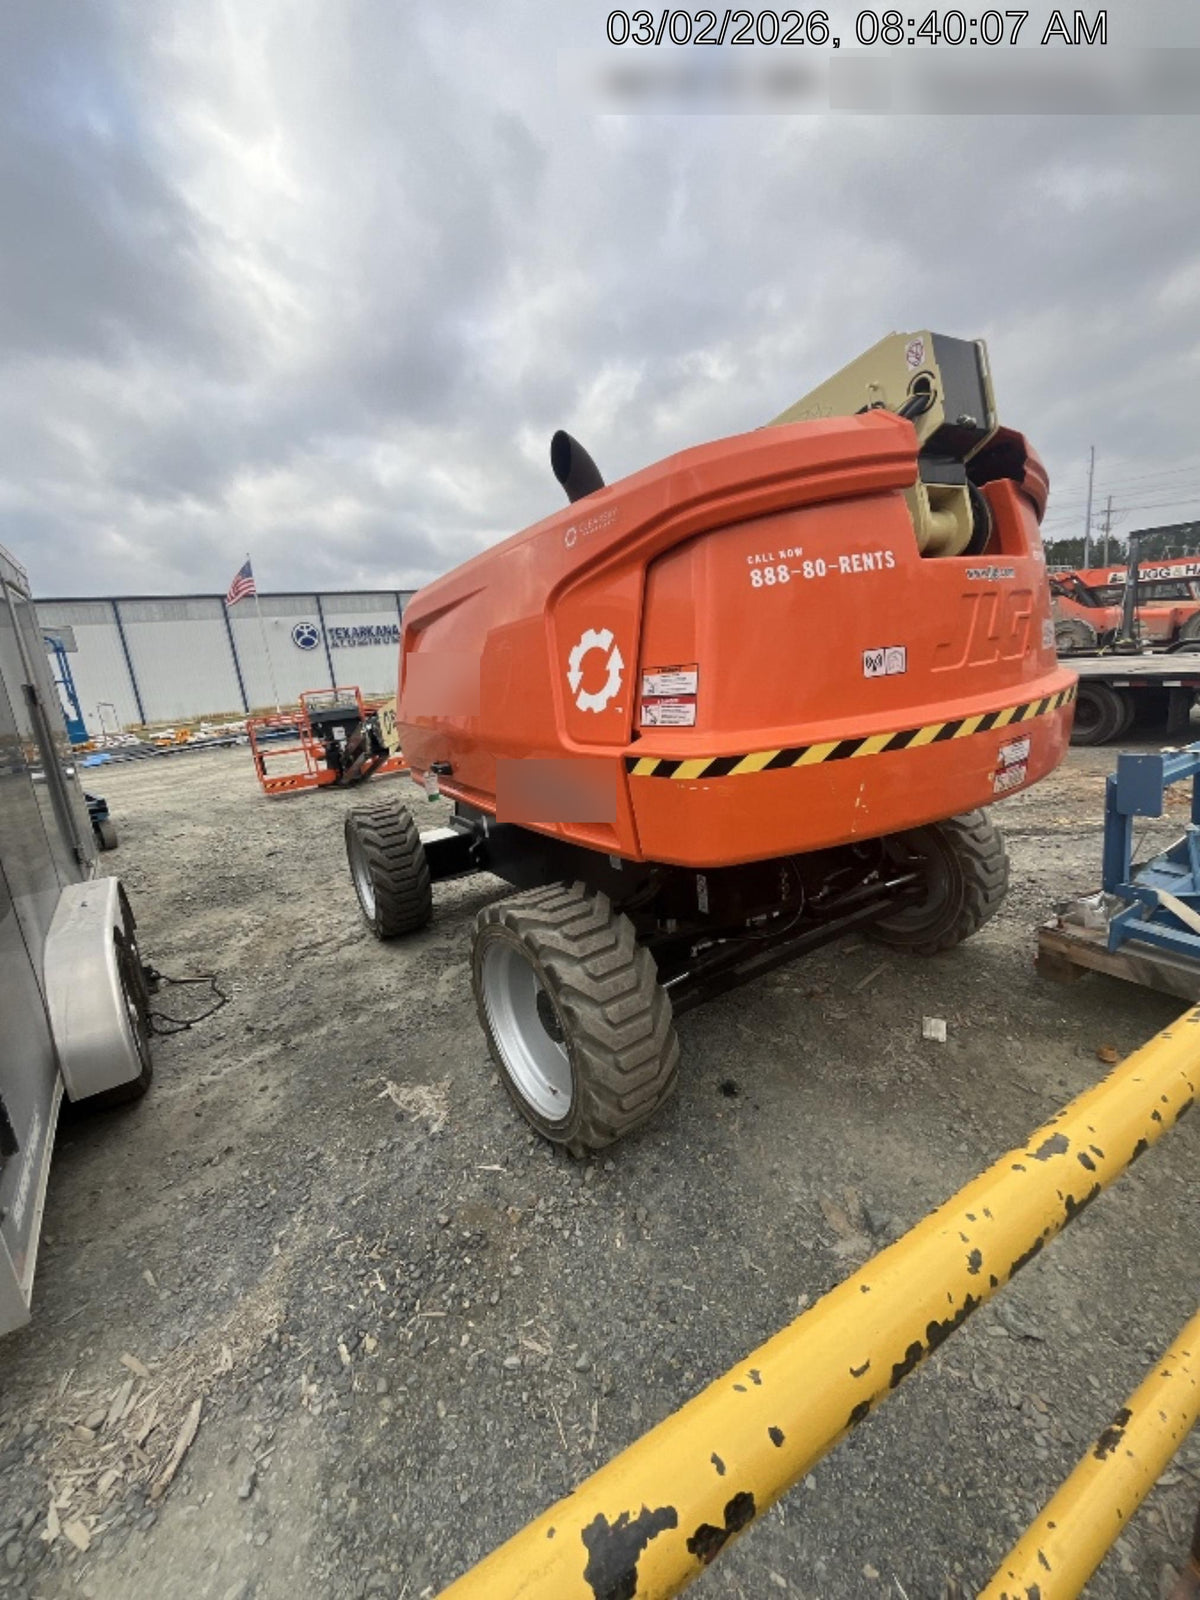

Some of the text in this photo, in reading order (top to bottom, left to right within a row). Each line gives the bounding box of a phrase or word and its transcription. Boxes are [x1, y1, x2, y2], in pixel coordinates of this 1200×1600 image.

[747, 547, 804, 565] CALL NOW
[750, 550, 896, 588] 888-80-RENTS
[327, 624, 399, 639] TEXARKANA
[930, 589, 1032, 672] JLG
